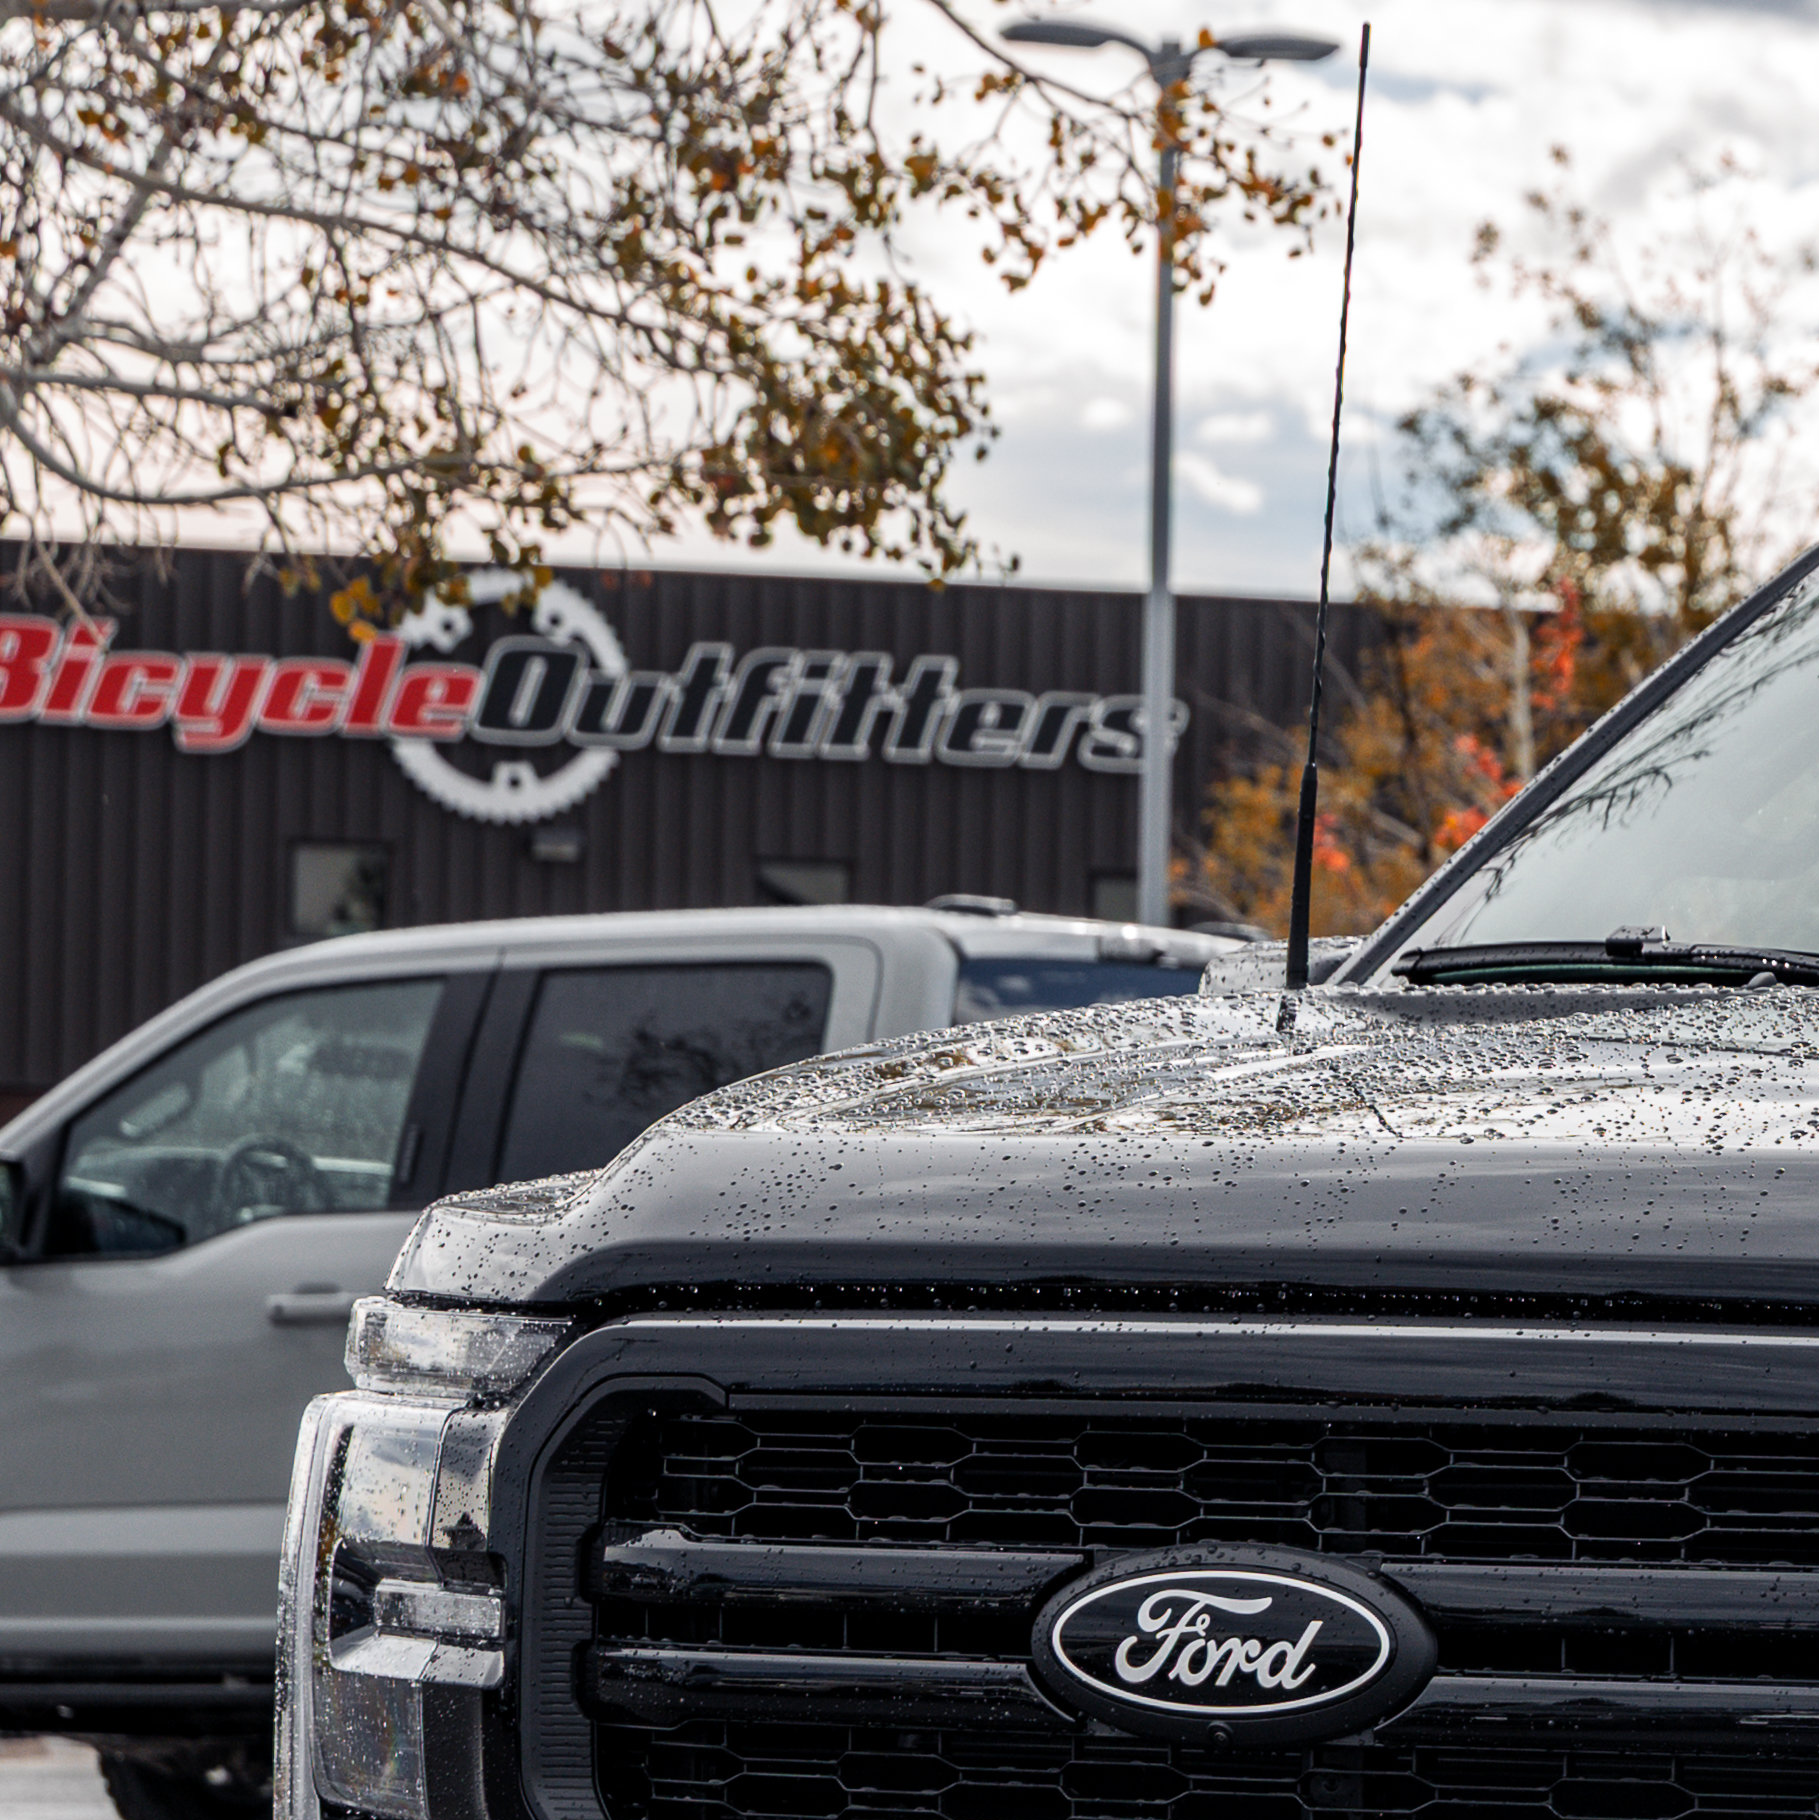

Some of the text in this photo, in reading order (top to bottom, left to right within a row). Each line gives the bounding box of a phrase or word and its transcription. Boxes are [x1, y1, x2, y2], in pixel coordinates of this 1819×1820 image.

[0, 612, 1189, 774] Bicycle Outfitters
[1115, 1589, 1323, 1689] Ford
